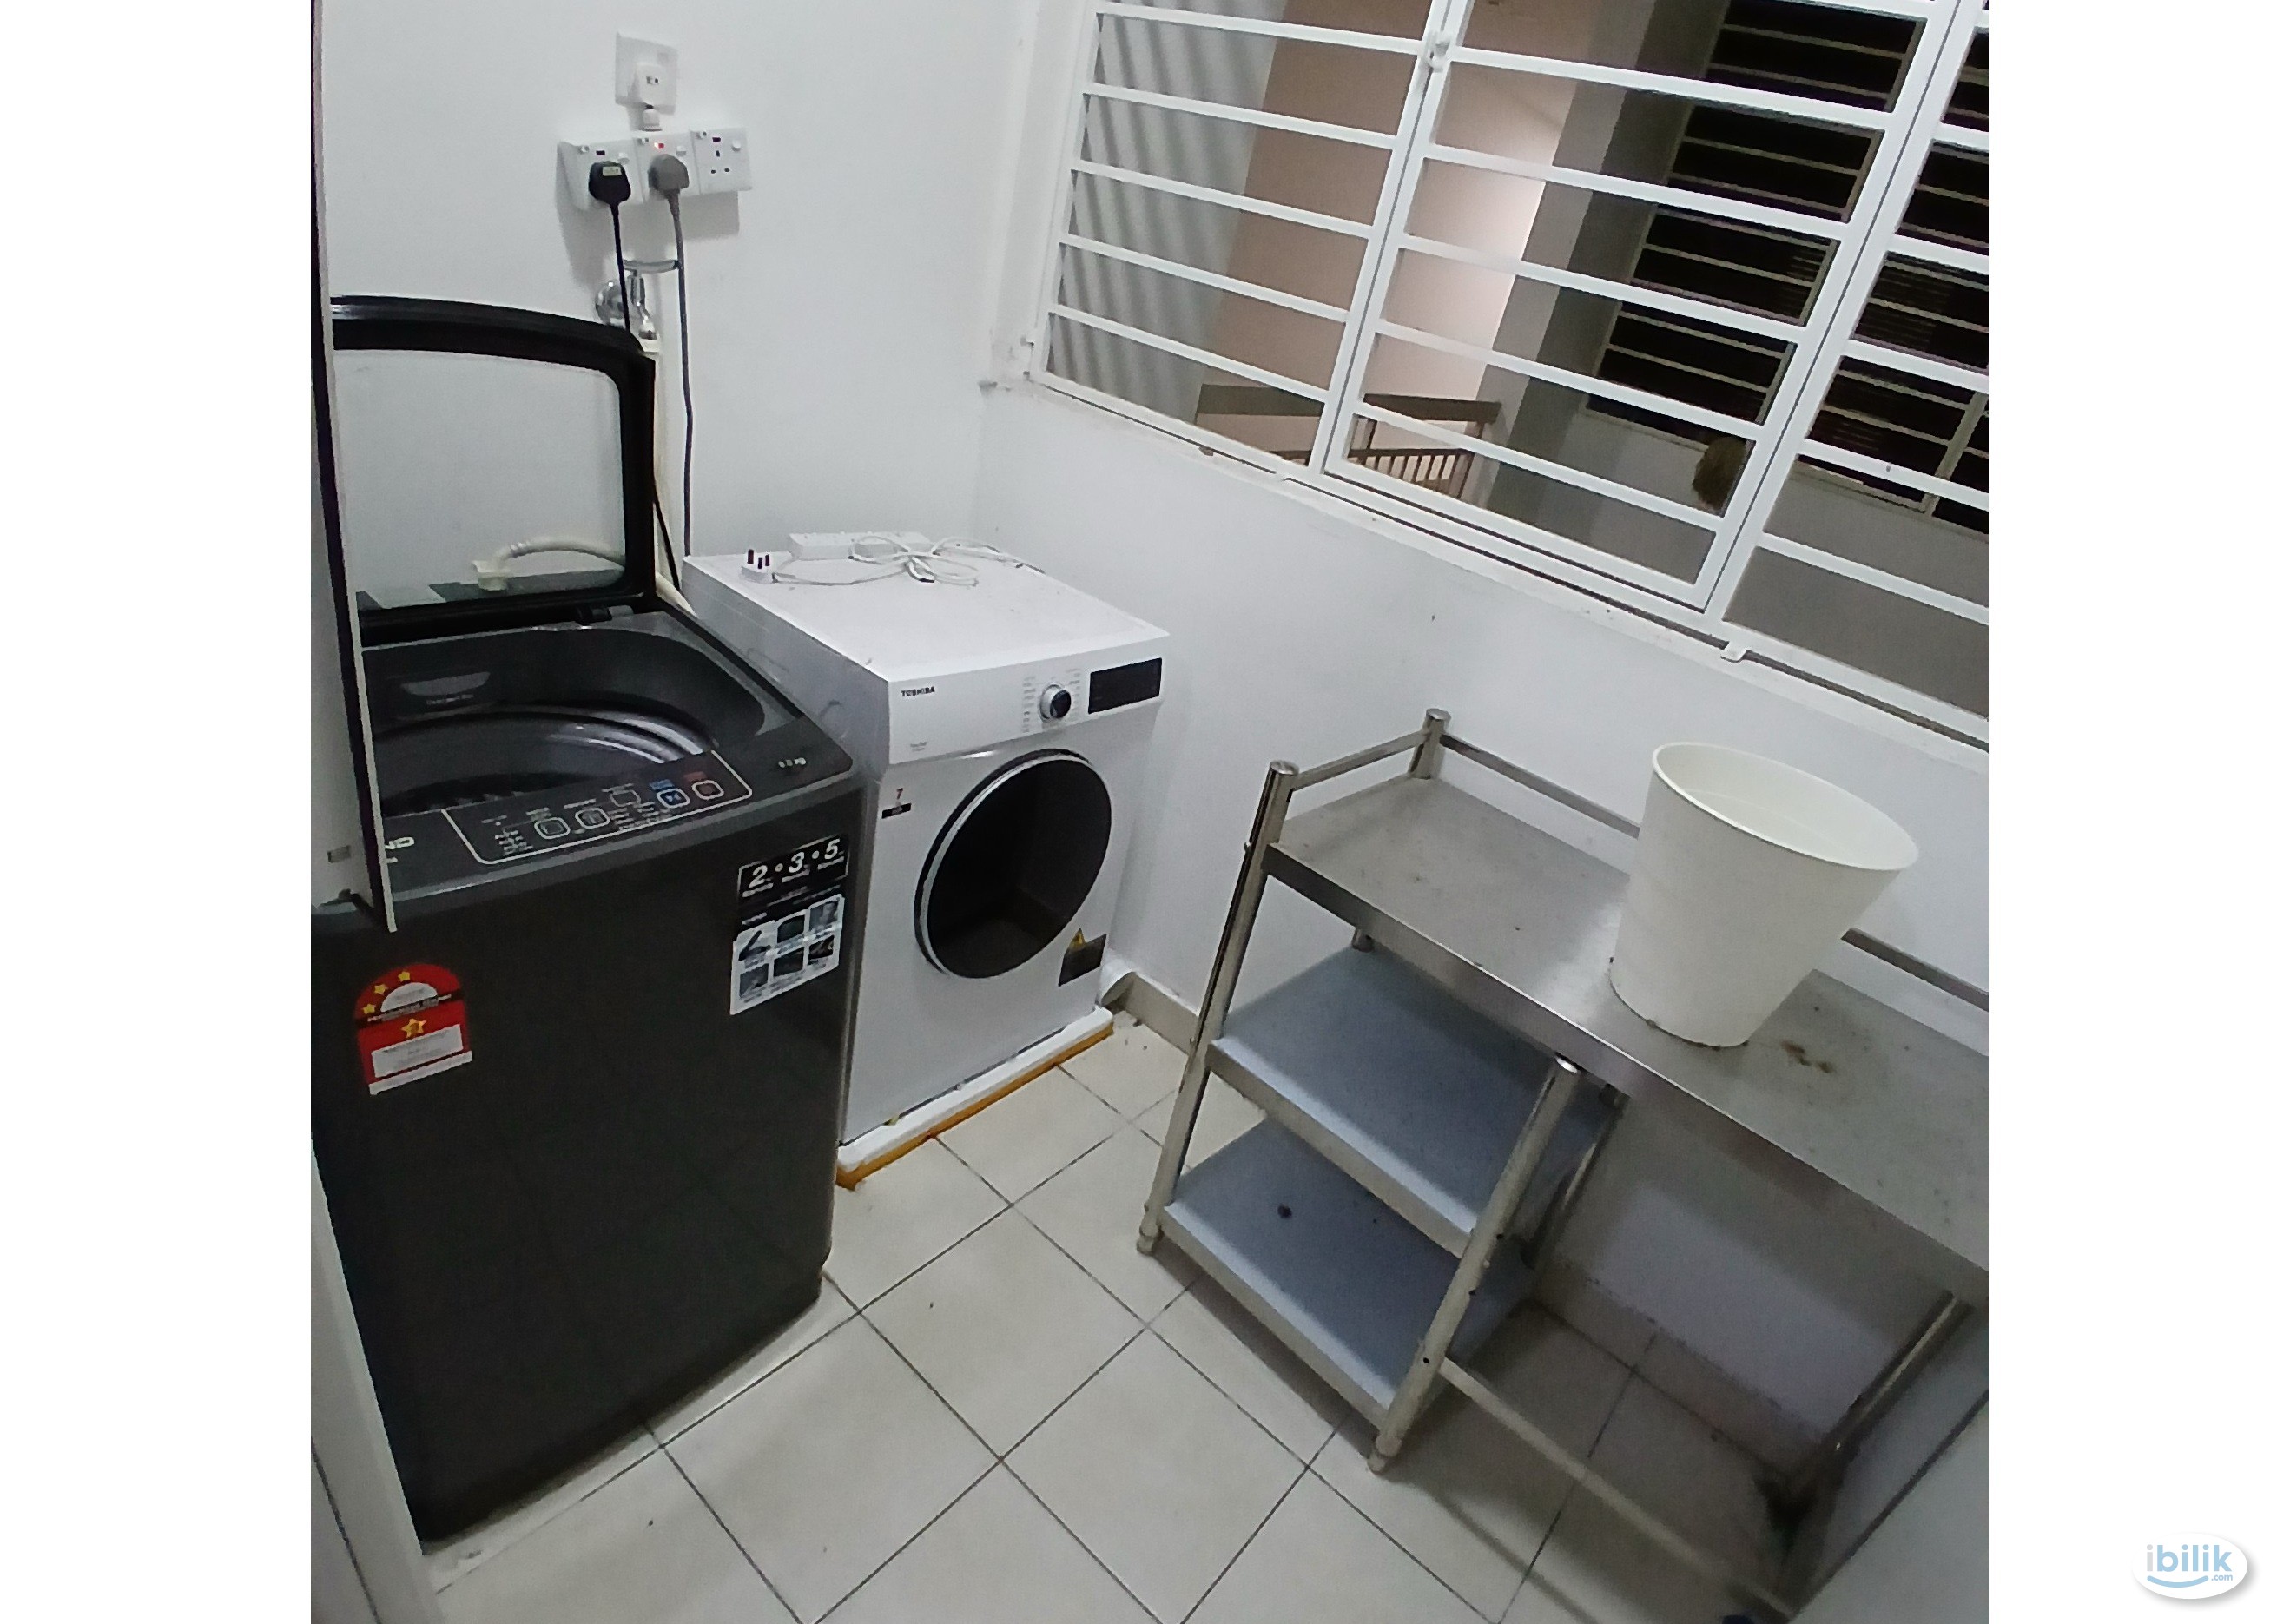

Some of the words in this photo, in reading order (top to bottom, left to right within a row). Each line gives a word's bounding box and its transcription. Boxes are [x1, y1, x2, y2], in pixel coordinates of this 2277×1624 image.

[901, 686, 935, 697] TOSHIBA
[749, 865, 768, 888] 2
[788, 851, 805, 873] 3
[824, 838, 840, 860] 5
